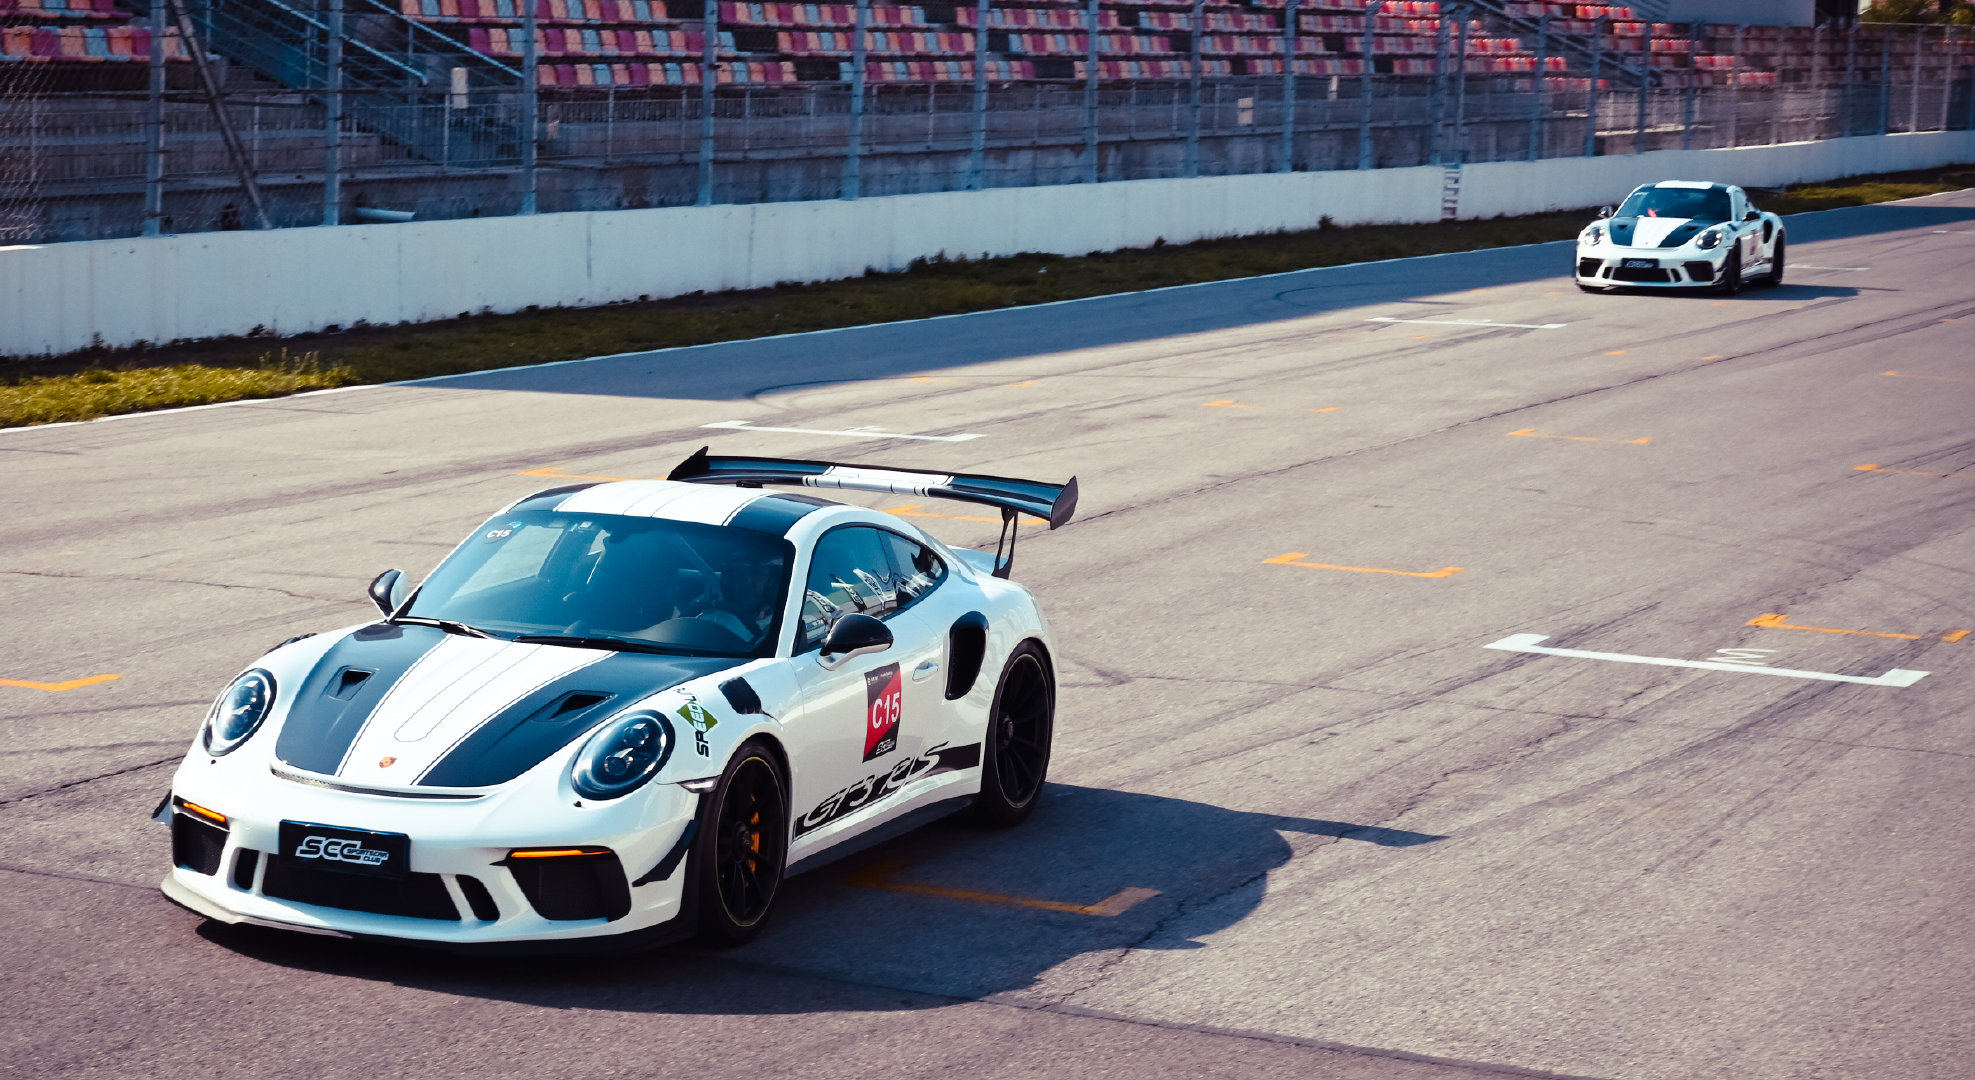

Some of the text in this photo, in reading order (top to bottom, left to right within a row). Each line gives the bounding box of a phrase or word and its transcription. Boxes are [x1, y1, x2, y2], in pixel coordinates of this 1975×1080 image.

[486, 529, 512, 539] C15
[872, 692, 900, 729] C15
[802, 741, 949, 828] GT3 RS
[295, 836, 361, 862] SCC
[346, 848, 389, 859] SPORTSCAR
[363, 855, 382, 863] CLUB
